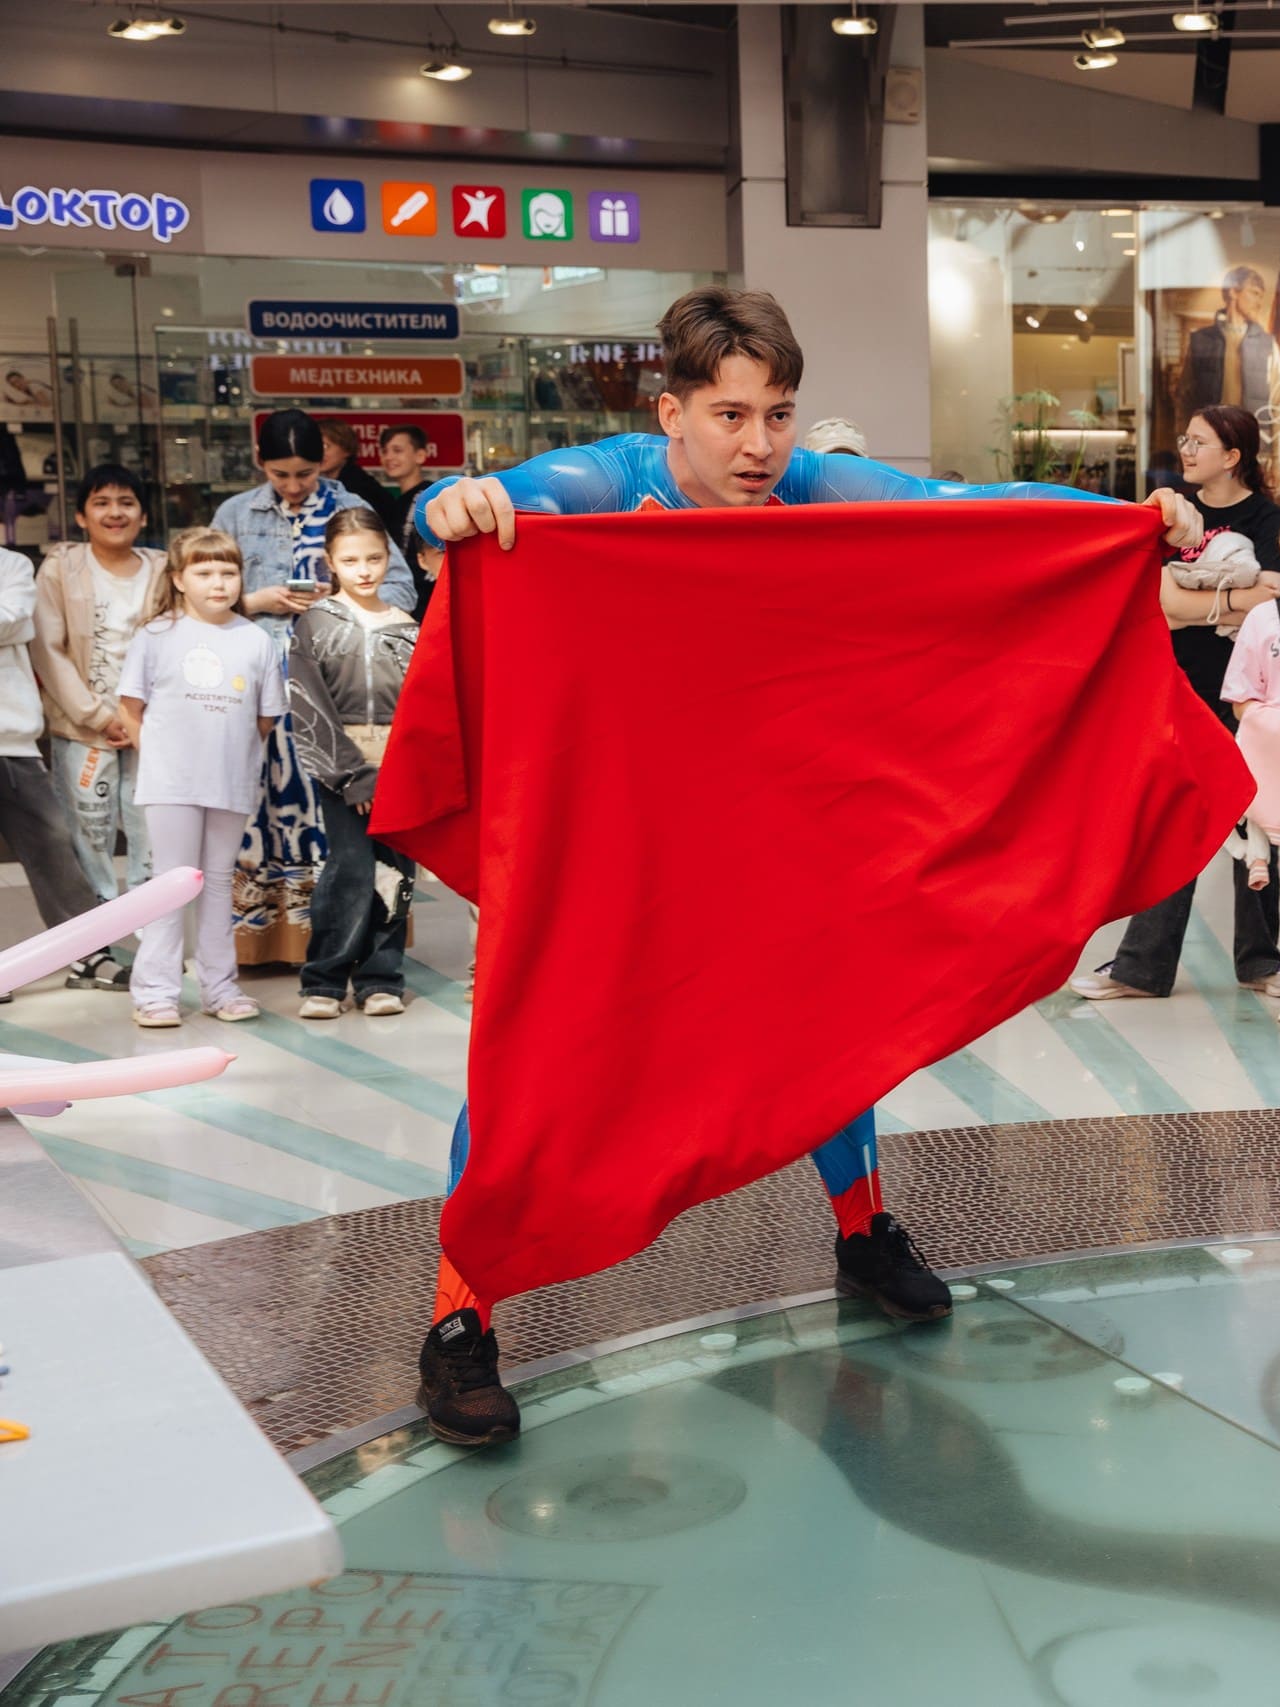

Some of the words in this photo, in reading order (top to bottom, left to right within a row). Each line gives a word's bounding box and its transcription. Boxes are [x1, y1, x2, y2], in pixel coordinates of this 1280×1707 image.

[0, 186, 190, 243] октор
[262, 311, 448, 331] ВОДООЧИСТИТЕЛИ
[289, 367, 423, 387] МЕДТЕХНИКА
[203, 704, 228, 714] TIME
